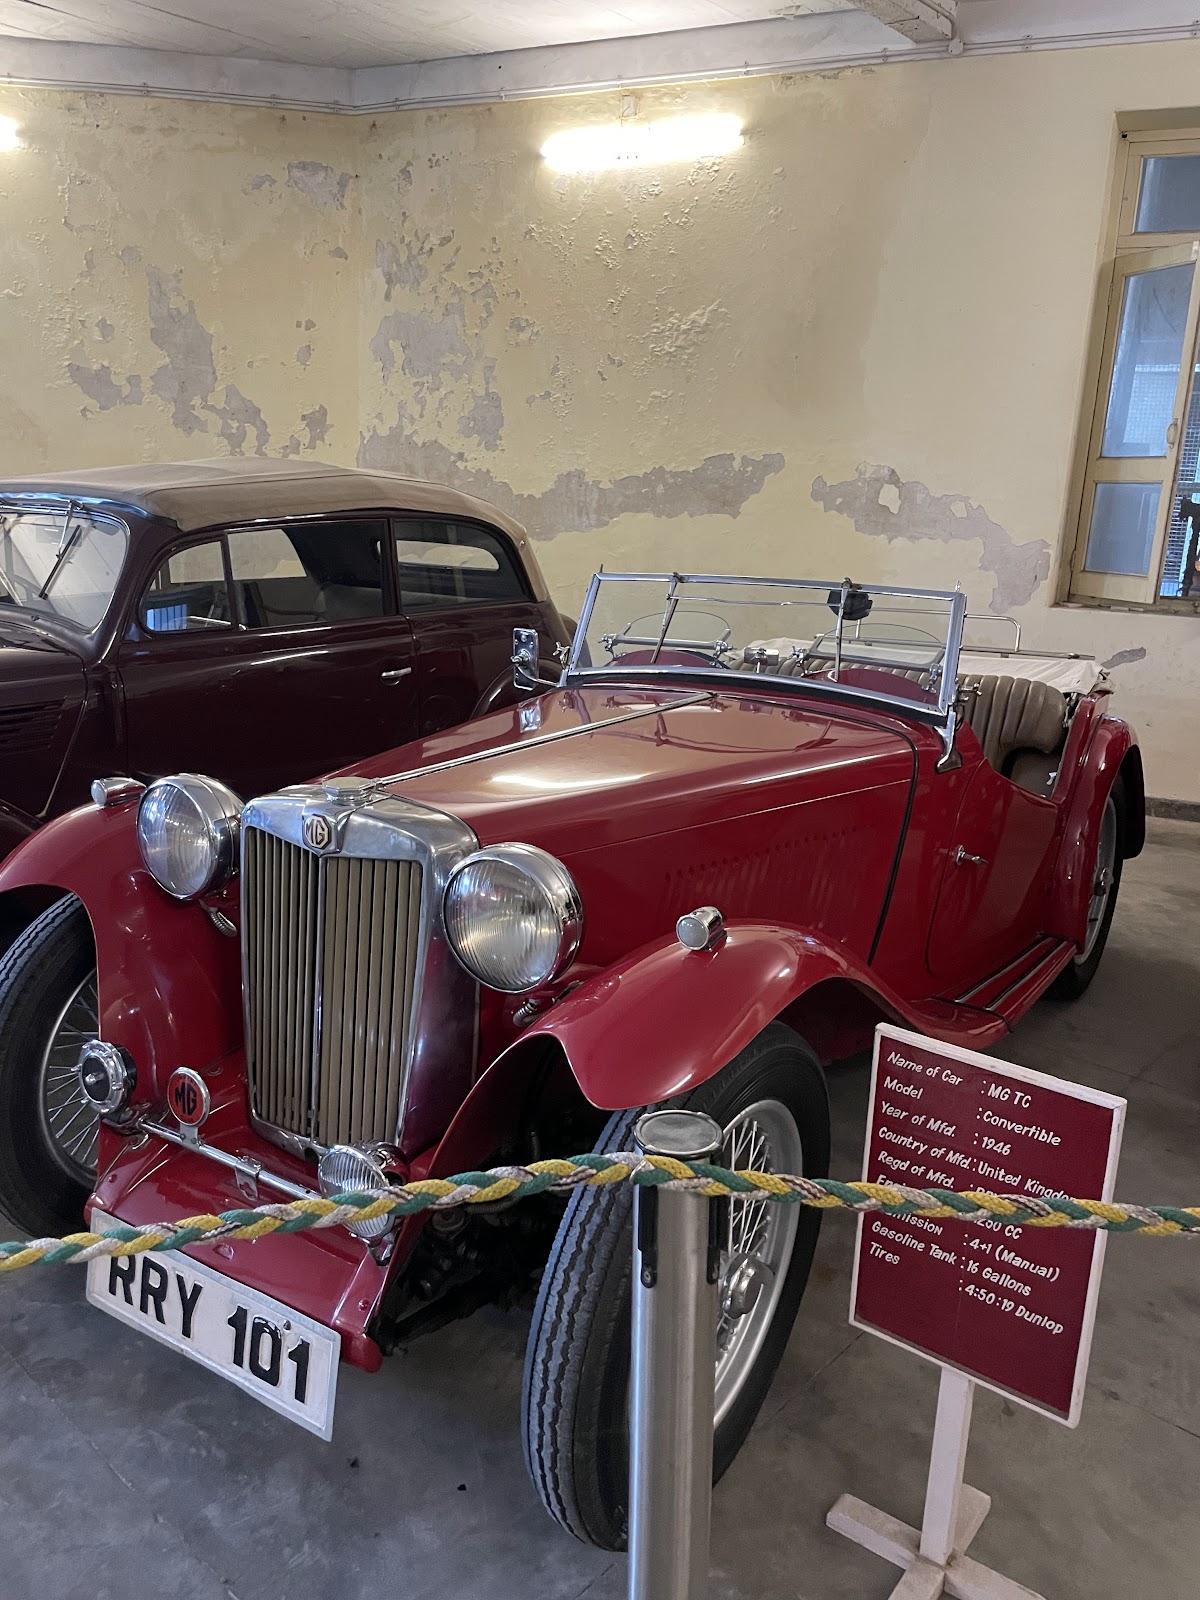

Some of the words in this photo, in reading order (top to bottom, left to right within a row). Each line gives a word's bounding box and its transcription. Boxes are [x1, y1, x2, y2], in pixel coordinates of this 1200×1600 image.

[305, 818, 326, 846] MG
[175, 1081, 198, 1116] MG
[884, 1076, 923, 1099] Model
[887, 1052, 923, 1072] Name
[926, 1067, 941, 1077] of
[942, 1070, 963, 1085] Car
[1014, 1091, 1031, 1108] TC
[882, 1101, 909, 1119] Year
[912, 1115, 926, 1125] of
[927, 1118, 956, 1137] Mfd.
[878, 1151, 910, 1170] Regd
[911, 1166, 926, 1176] of
[926, 1169, 954, 1188] Mfd.
[879, 1127, 928, 1154] Country
[931, 1148, 946, 1158] of
[945, 1151, 971, 1169] Mfd.
[1024, 1178, 1077, 1201] Kingdo
[1005, 1225, 1022, 1239] CC
[872, 1221, 925, 1251] Gasoline
[930, 1244, 957, 1265] Tank
[982, 1268, 1031, 1295] Gallons
[995, 1245, 1059, 1282] (Manual)
[870, 1242, 900, 1264] Tires
[1015, 1306, 1063, 1334] Dunlop
[108, 1254, 203, 1339] RRY
[227, 1305, 311, 1404] 101
